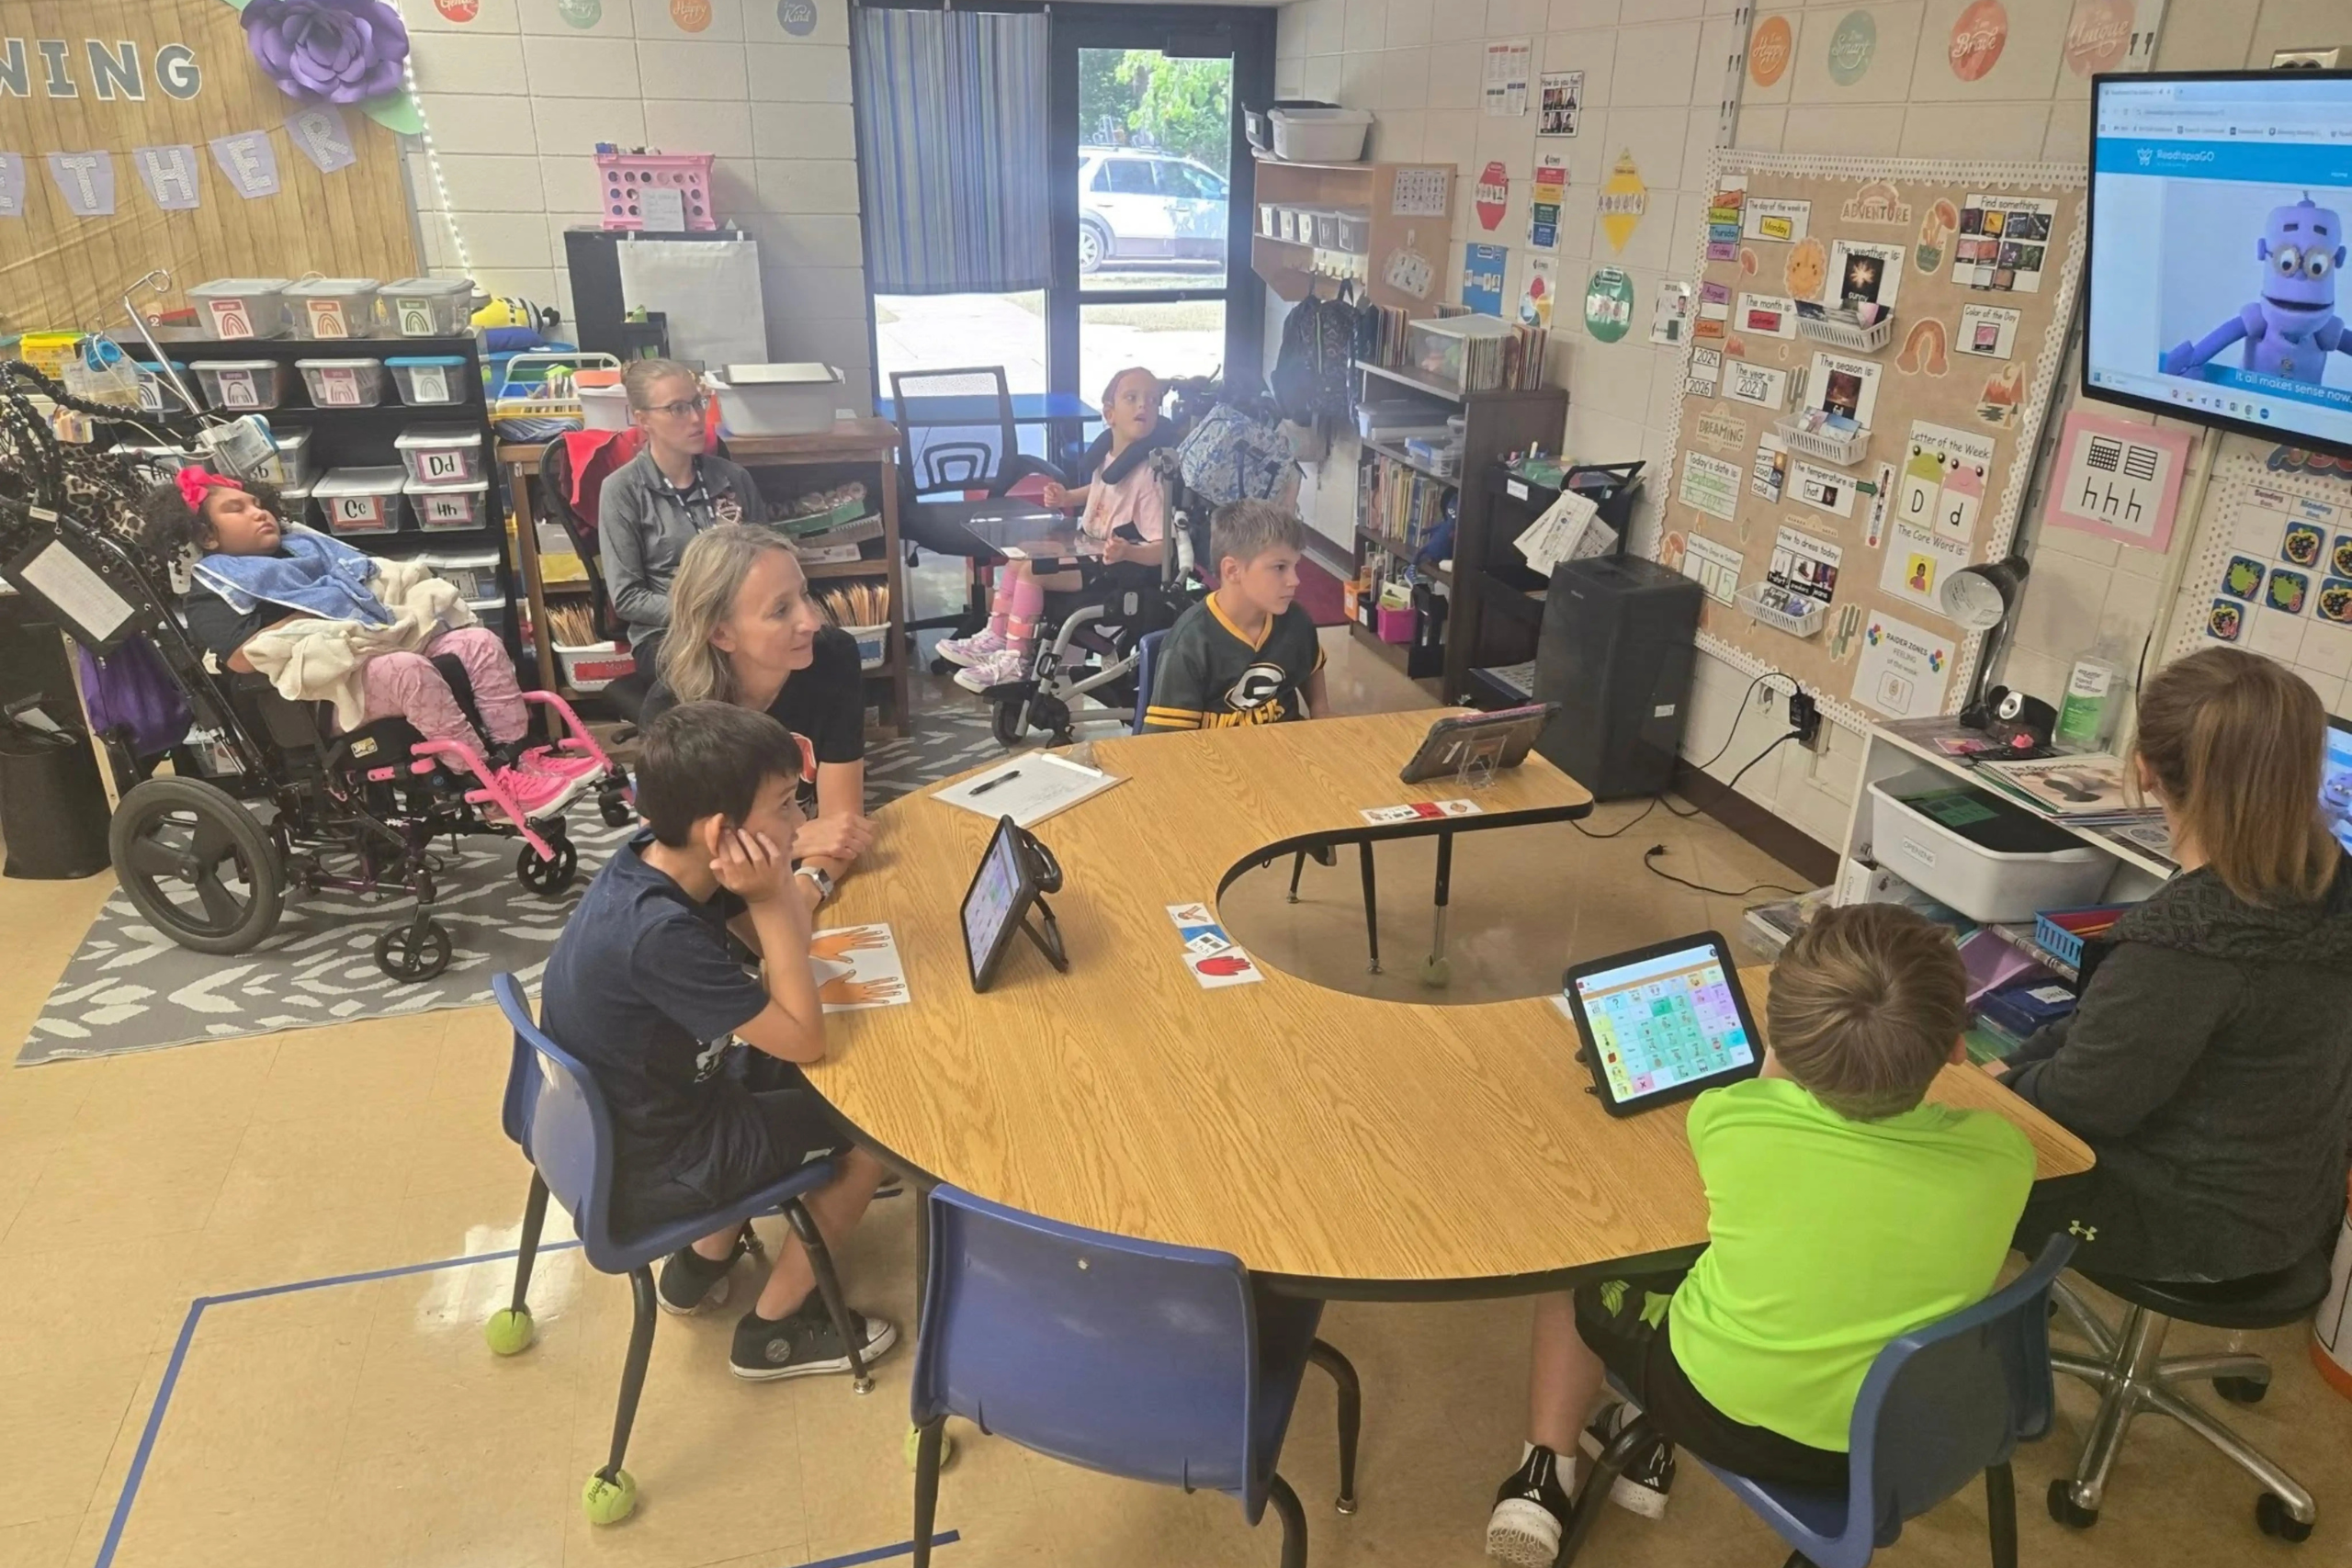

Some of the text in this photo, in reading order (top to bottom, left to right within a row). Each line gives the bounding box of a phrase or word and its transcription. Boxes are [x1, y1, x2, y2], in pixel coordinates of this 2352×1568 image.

[784, 5, 810, 22] Kind
[1951, 27, 1998, 57] Brave
[2069, 20, 2129, 52] Unique
[2156, 148, 2215, 163] ReadtopiaGO
[1749, 199, 1758, 209] The
[1758, 201, 1768, 211] day
[1777, 202, 1786, 210] the
[1787, 203, 1801, 211] week
[1981, 196, 1996, 208] Find
[1843, 203, 1908, 222] ADVENTURE
[1711, 226, 1737, 238] Thursday
[1764, 221, 1788, 234] Monday
[1713, 246, 1730, 257] Friday
[1838, 241, 1851, 254] The
[1853, 245, 1888, 259] weather
[1706, 287, 1724, 299] August
[1848, 291, 1870, 303] sunny
[1747, 295, 1758, 307] The
[1760, 299, 1782, 310] month
[1965, 307, 2017, 323] Color of the Day
[1697, 322, 1719, 333] October
[1697, 350, 1718, 366] 2024
[1820, 354, 1834, 368] The
[1836, 362, 1862, 375] season
[1736, 363, 1747, 376] The
[1750, 370, 1765, 380] year
[1689, 379, 1710, 396] 2026
[2235, 370, 2245, 382] It
[2245, 373, 2258, 385] all
[2259, 375, 2292, 391] makes
[2295, 381, 2324, 399] sense
[1699, 420, 1744, 442] DREAMING
[1911, 430, 1937, 445] Letter
[1938, 437, 1948, 448] of
[1950, 441, 1962, 453] the
[429, 455, 455, 477] Dd
[1690, 451, 1713, 470] Today's
[1714, 462, 1729, 476] date
[1794, 459, 1804, 472] The
[1807, 467, 1847, 486] temperature
[1753, 482, 1768, 494] cold
[1806, 484, 1819, 497] hot
[345, 499, 367, 519] Cc
[436, 501, 458, 516] Hh
[1911, 489, 1925, 513] D
[2300, 499, 2333, 515] Monday
[1950, 502, 1964, 526] d
[1779, 528, 1792, 542] How
[1793, 535, 1801, 545] to
[1801, 537, 1818, 552] dress
[1898, 524, 1911, 537] The
[1913, 530, 1930, 544] Core
[1932, 536, 1954, 553] Word
[1886, 633, 1928, 656] RAIDER ZONES
[1894, 648, 1917, 663] FEELING
[1225, 662, 1285, 710] G
[1903, 840, 1934, 863] OPENING
